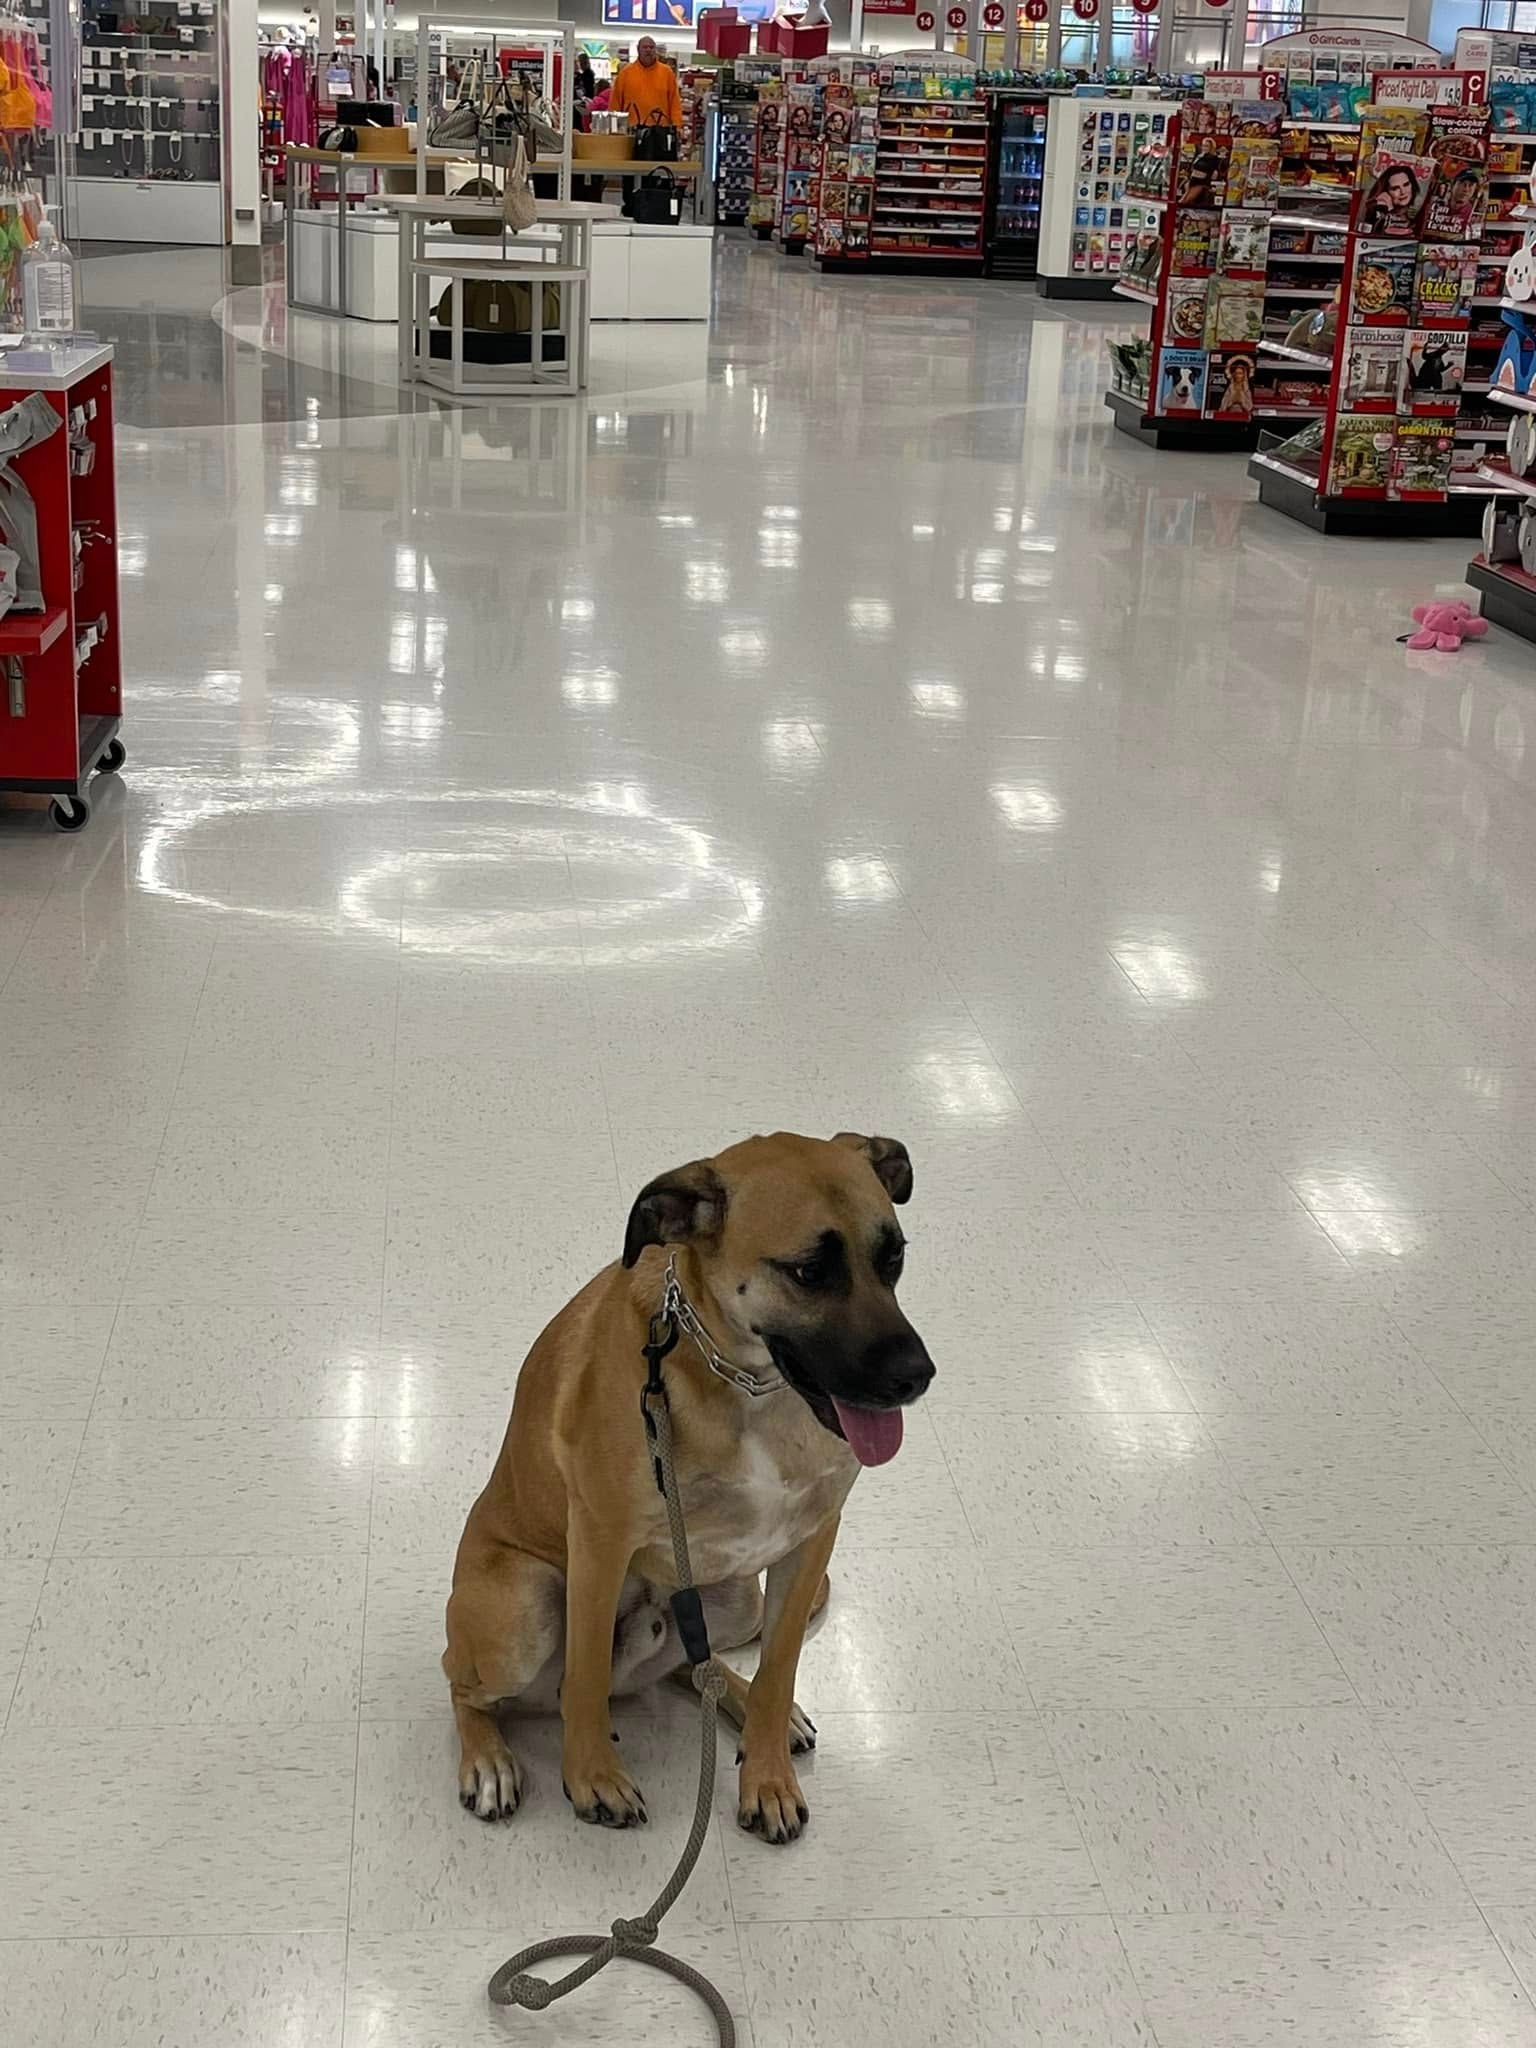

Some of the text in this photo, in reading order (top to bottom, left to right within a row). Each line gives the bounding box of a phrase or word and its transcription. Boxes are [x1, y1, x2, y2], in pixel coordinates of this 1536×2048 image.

[1031, 4, 1044, 17] 11
[1080, 0, 1094, 12] 10
[950, 12, 963, 23] 13
[988, 9, 1001, 20] 12
[920, 16, 932, 27] 14
[1377, 79, 1440, 102] Priced Right Daily
[1431, 116, 1488, 129] Slow-cooker
[1446, 127, 1483, 137] comfort
[1377, 135, 1413, 153] Sudoku
[1419, 281, 1459, 297] CRACKS
[1428, 331, 1467, 345] GODZILLA
[1430, 427, 1456, 438] STYLE
